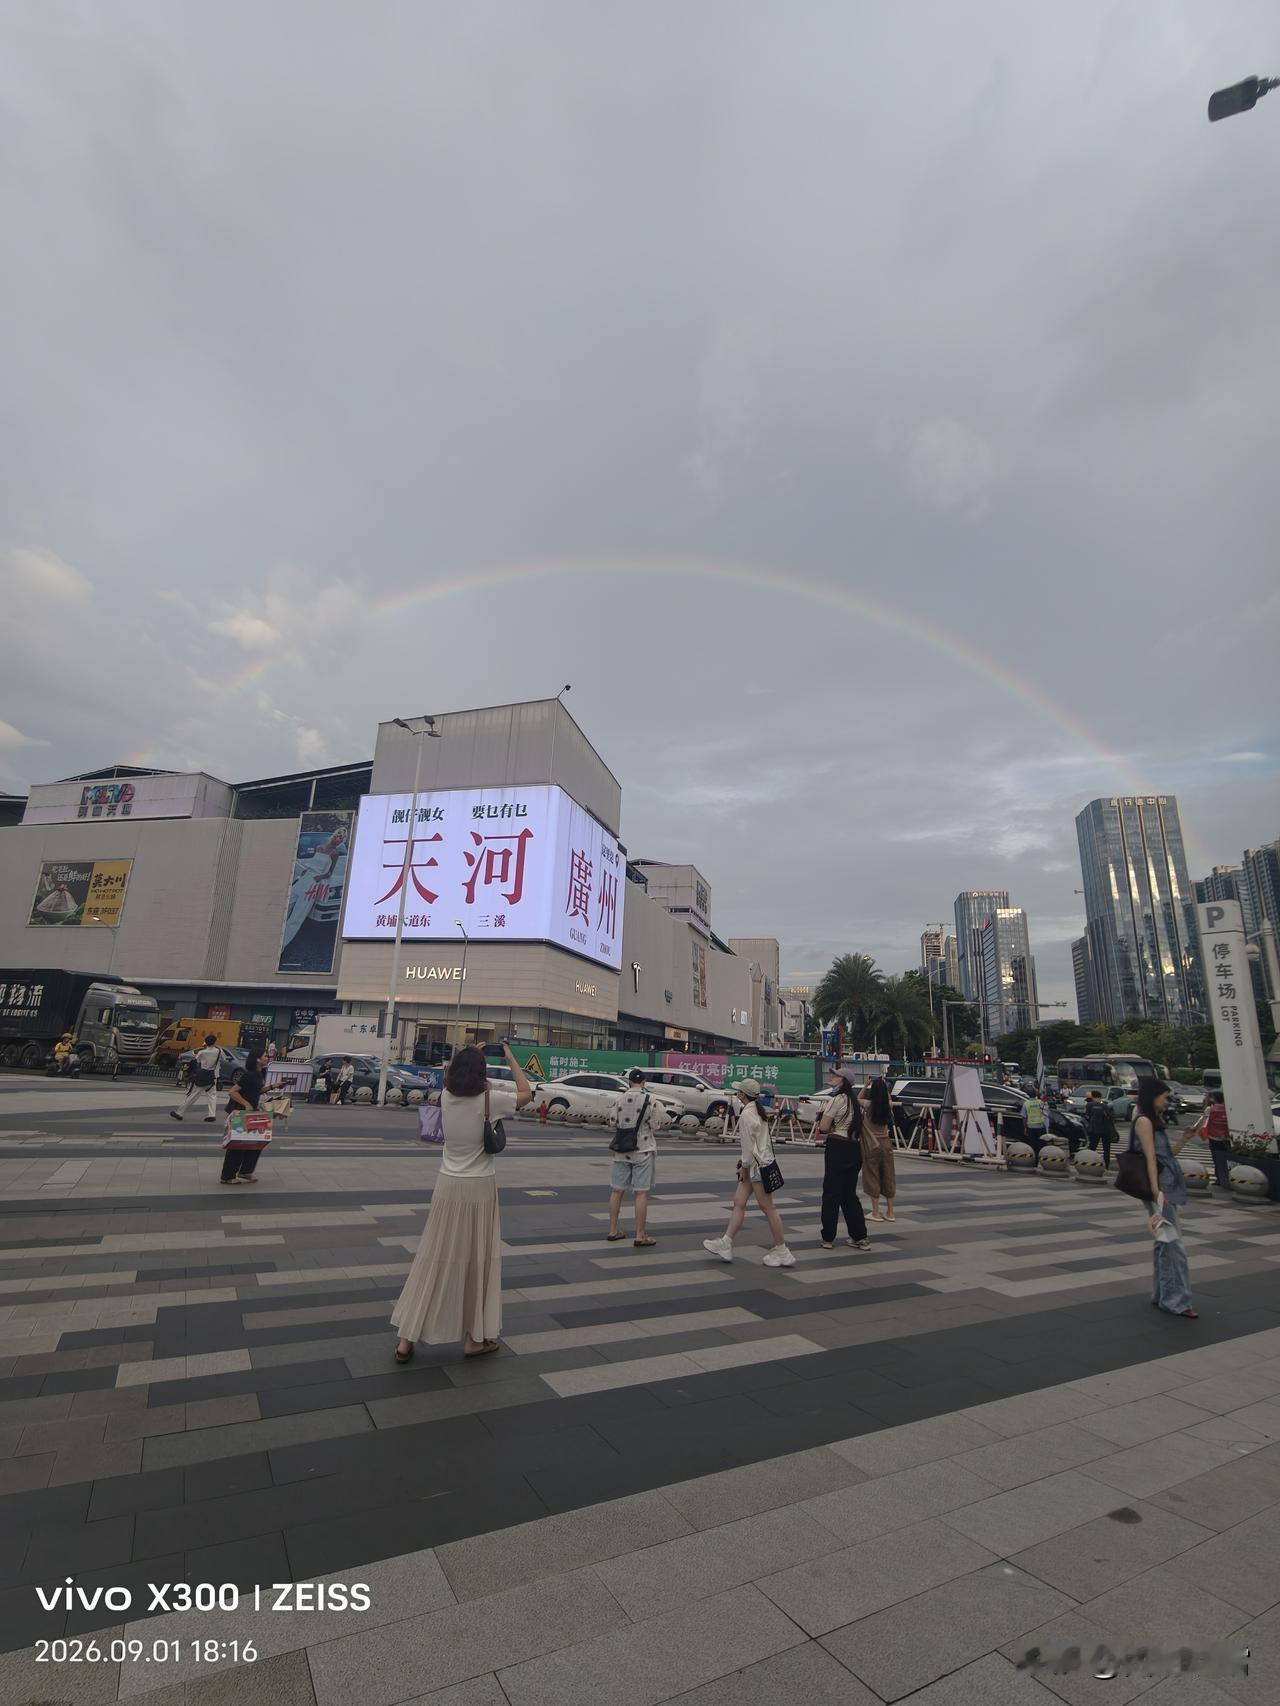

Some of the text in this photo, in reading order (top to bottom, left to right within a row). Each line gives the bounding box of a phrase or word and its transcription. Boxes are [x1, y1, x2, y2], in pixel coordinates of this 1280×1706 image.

[391, 806, 445, 823] 靓仔靓女
[374, 828, 535, 906] 天河
[565, 847, 618, 940] 廣州
[476, 914, 506, 928] 三溪
[1206, 906, 1225, 929] P
[570, 928, 587, 945] GUANG
[405, 966, 467, 980] HUAWEI
[1211, 943, 1236, 1000] 停车场
[574, 980, 597, 997] HUAWEI
[10, 1008, 39, 1017] LOGISTCS
[1219, 1005, 1243, 1047] PARKING LOT
[549, 1056, 589, 1068] 临时施工
[678, 1061, 779, 1079] 红灯亮时可右转
